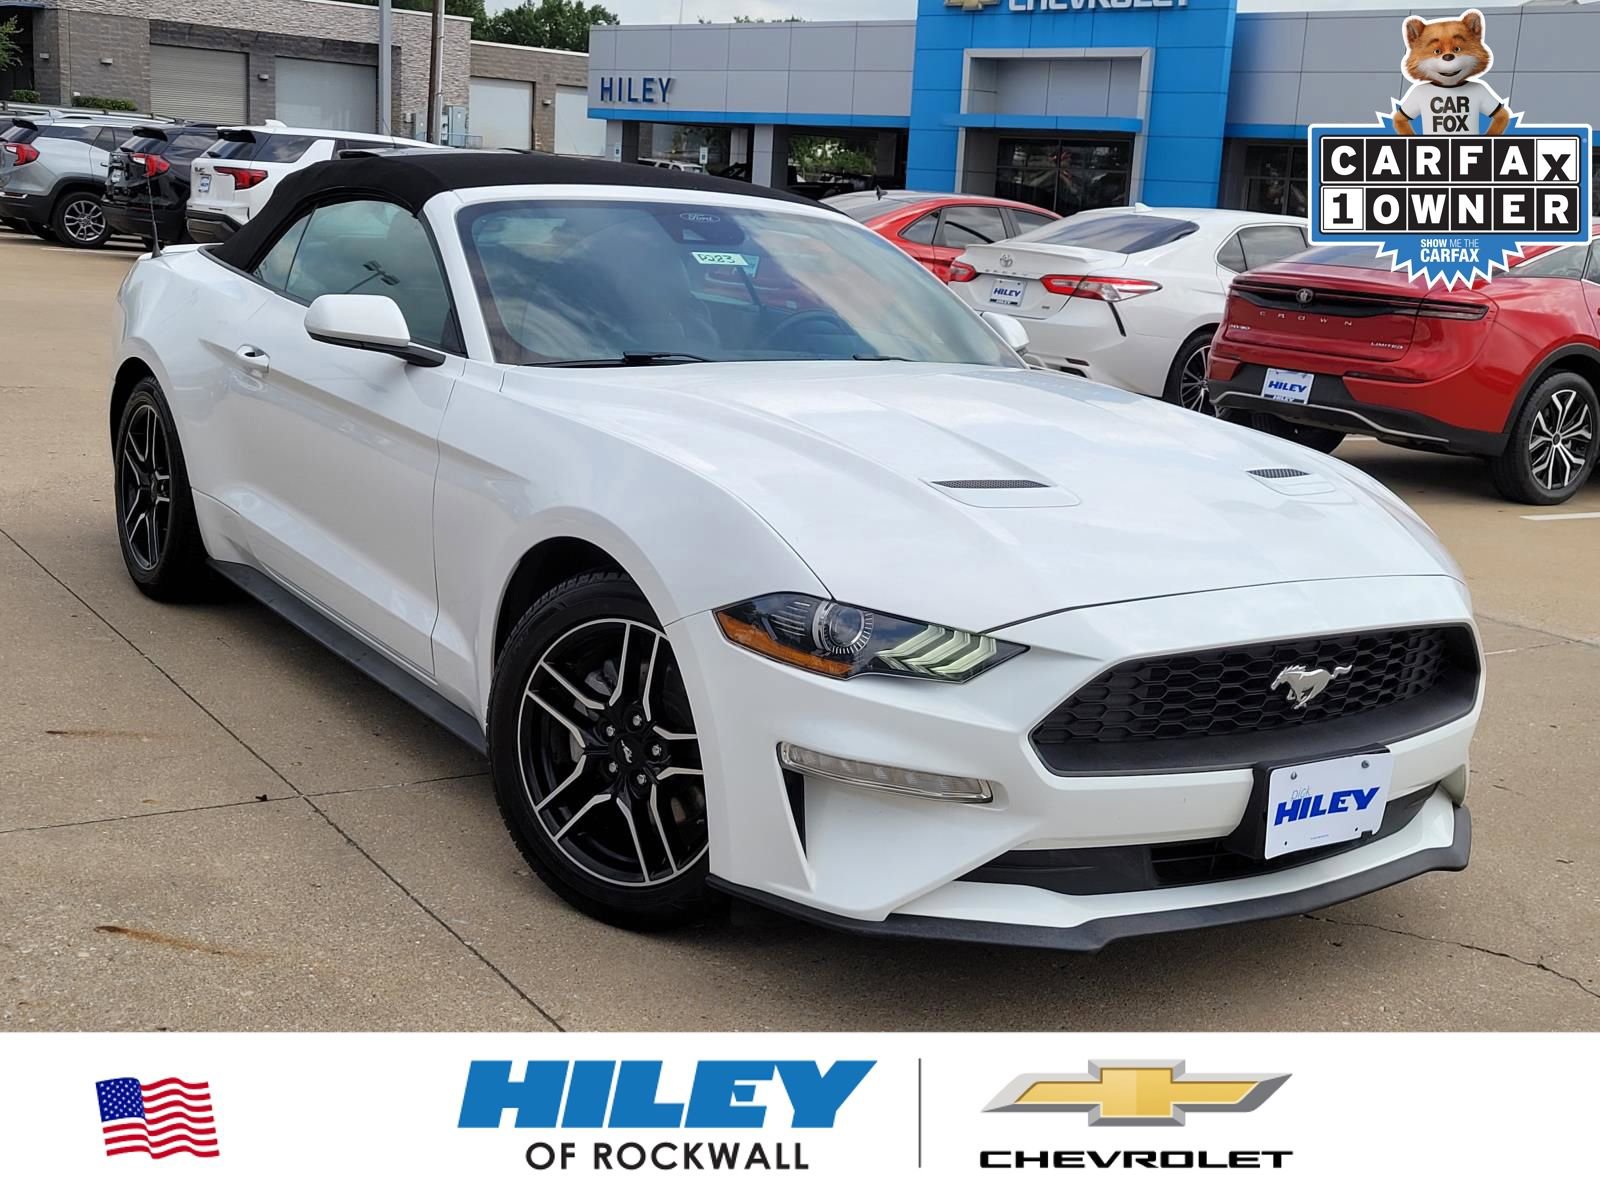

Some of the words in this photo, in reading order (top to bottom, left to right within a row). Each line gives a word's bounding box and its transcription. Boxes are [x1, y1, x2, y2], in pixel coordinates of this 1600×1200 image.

[600, 77, 672, 103] HILEY
[993, 287, 1021, 297] HILEY
[1259, 311, 1353, 327] CROWN
[1268, 380, 1307, 393] HILEY
[1274, 787, 1381, 826] HILEY
